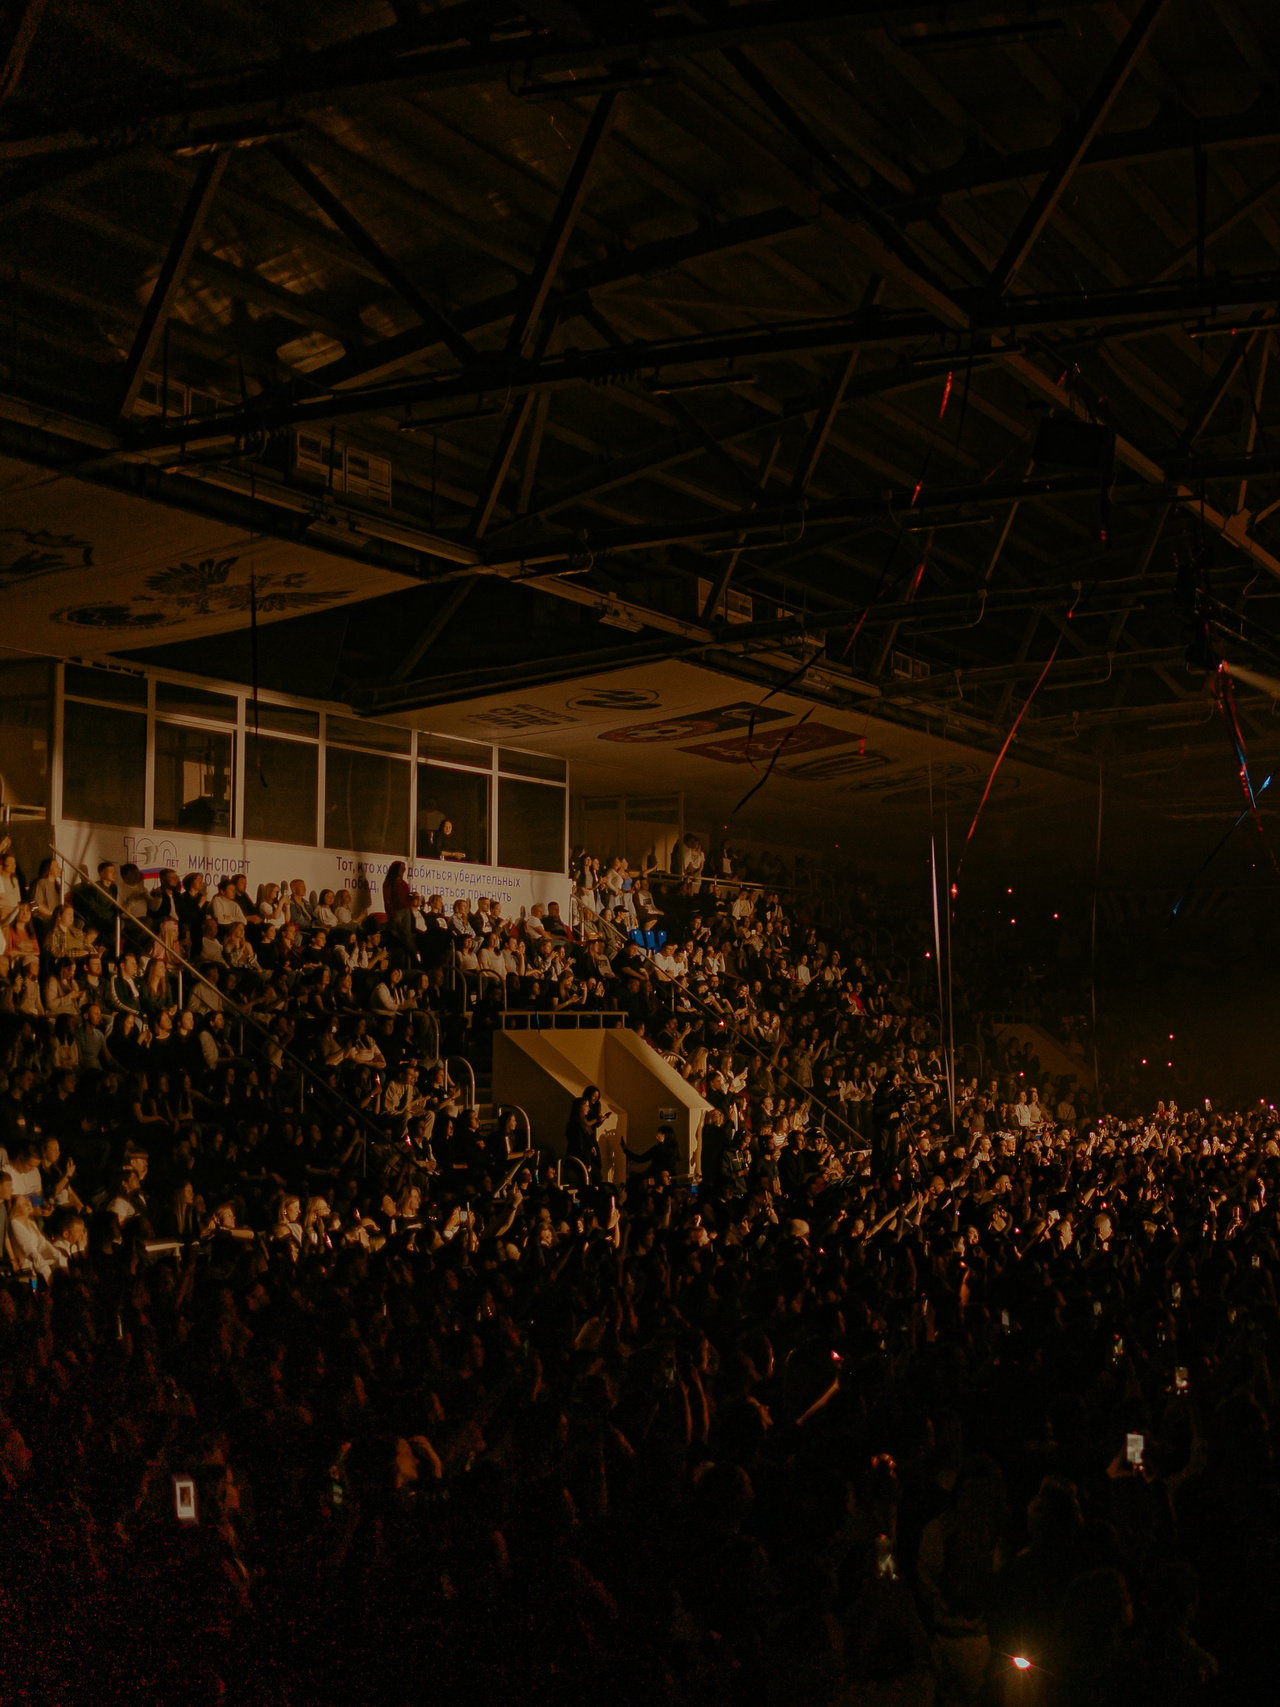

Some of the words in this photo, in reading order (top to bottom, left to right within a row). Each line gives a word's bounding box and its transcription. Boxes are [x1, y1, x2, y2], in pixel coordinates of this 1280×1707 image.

[166, 859, 179, 868] ЛЕТ
[188, 855, 251, 874] МИНСПОРТ
[336, 856, 356, 874] Тот,
[357, 862, 375, 873] кто
[407, 865, 452, 880] добиться
[454, 869, 521, 888] убедительных
[344, 875, 379, 894] побед,
[420, 885, 465, 898] пытаться
[468, 889, 511, 903] прыгнуть
